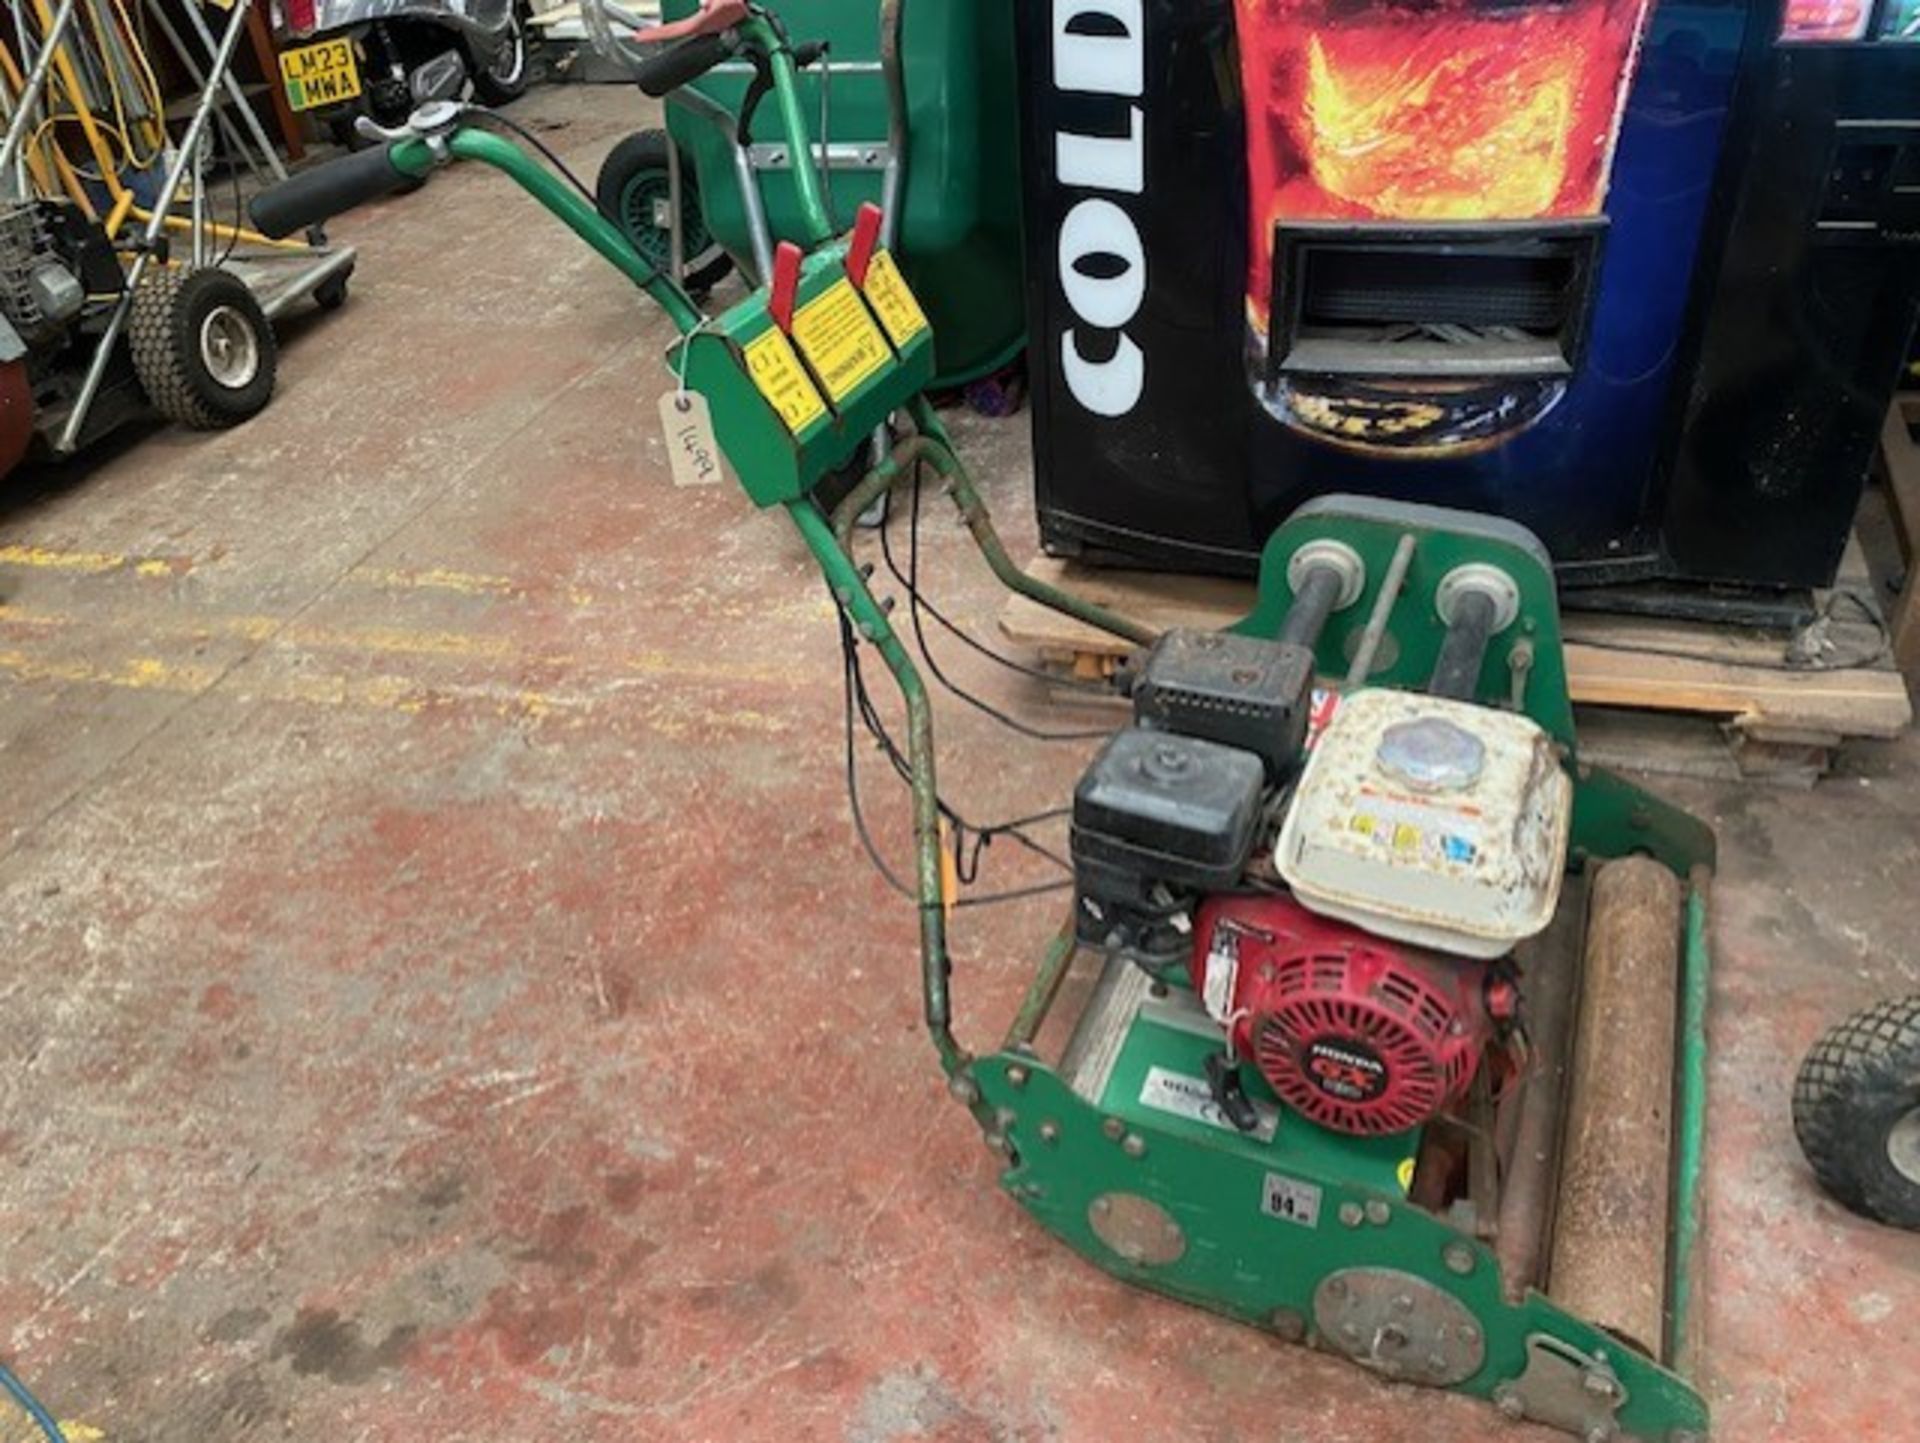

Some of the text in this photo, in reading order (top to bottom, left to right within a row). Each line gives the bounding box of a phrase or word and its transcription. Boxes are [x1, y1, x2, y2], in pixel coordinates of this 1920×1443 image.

[284, 43, 349, 79] LM23
[304, 71, 355, 103] MWA
[1052, 0, 1147, 417] COLD
[677, 424, 715, 479] 1499
[1312, 1044, 1384, 1074] HONDA
